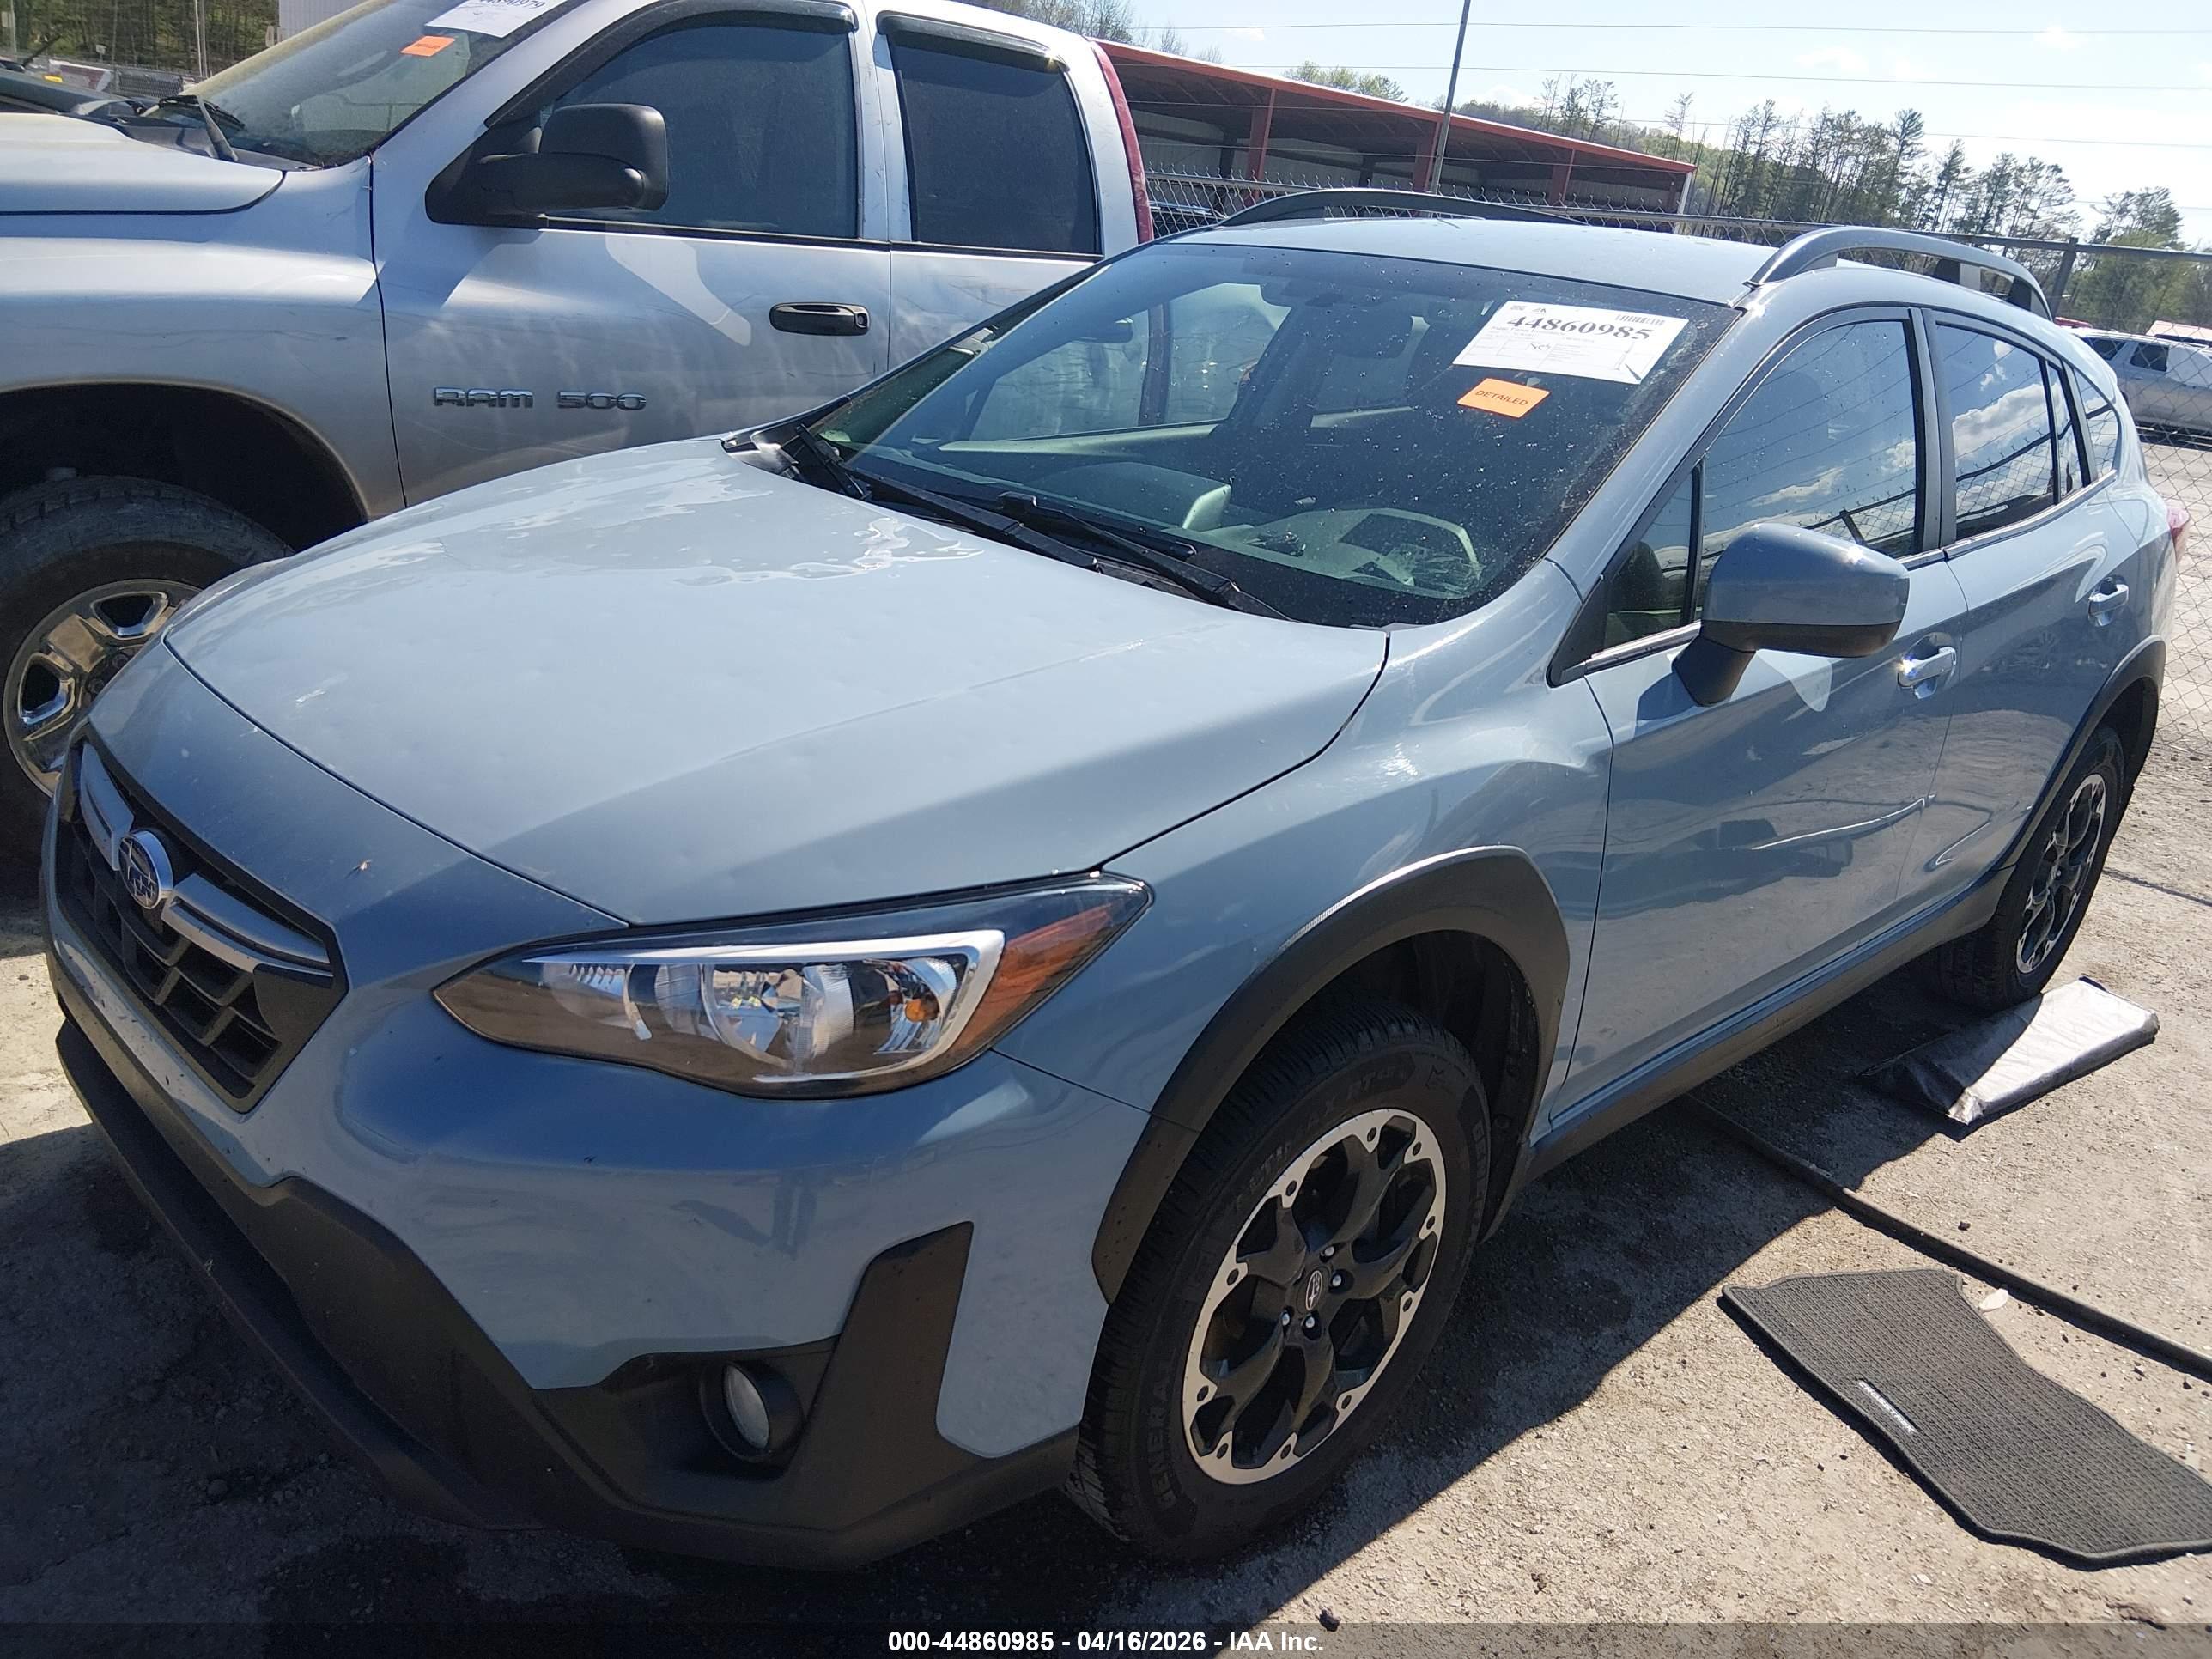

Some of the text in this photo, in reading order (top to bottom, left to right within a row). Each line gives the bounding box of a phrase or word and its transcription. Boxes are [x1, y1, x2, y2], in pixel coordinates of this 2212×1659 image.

[1507, 315, 1654, 340] 44860985
[434, 387, 647, 410] RAM 500
[1475, 390, 1528, 405] DETAILED
